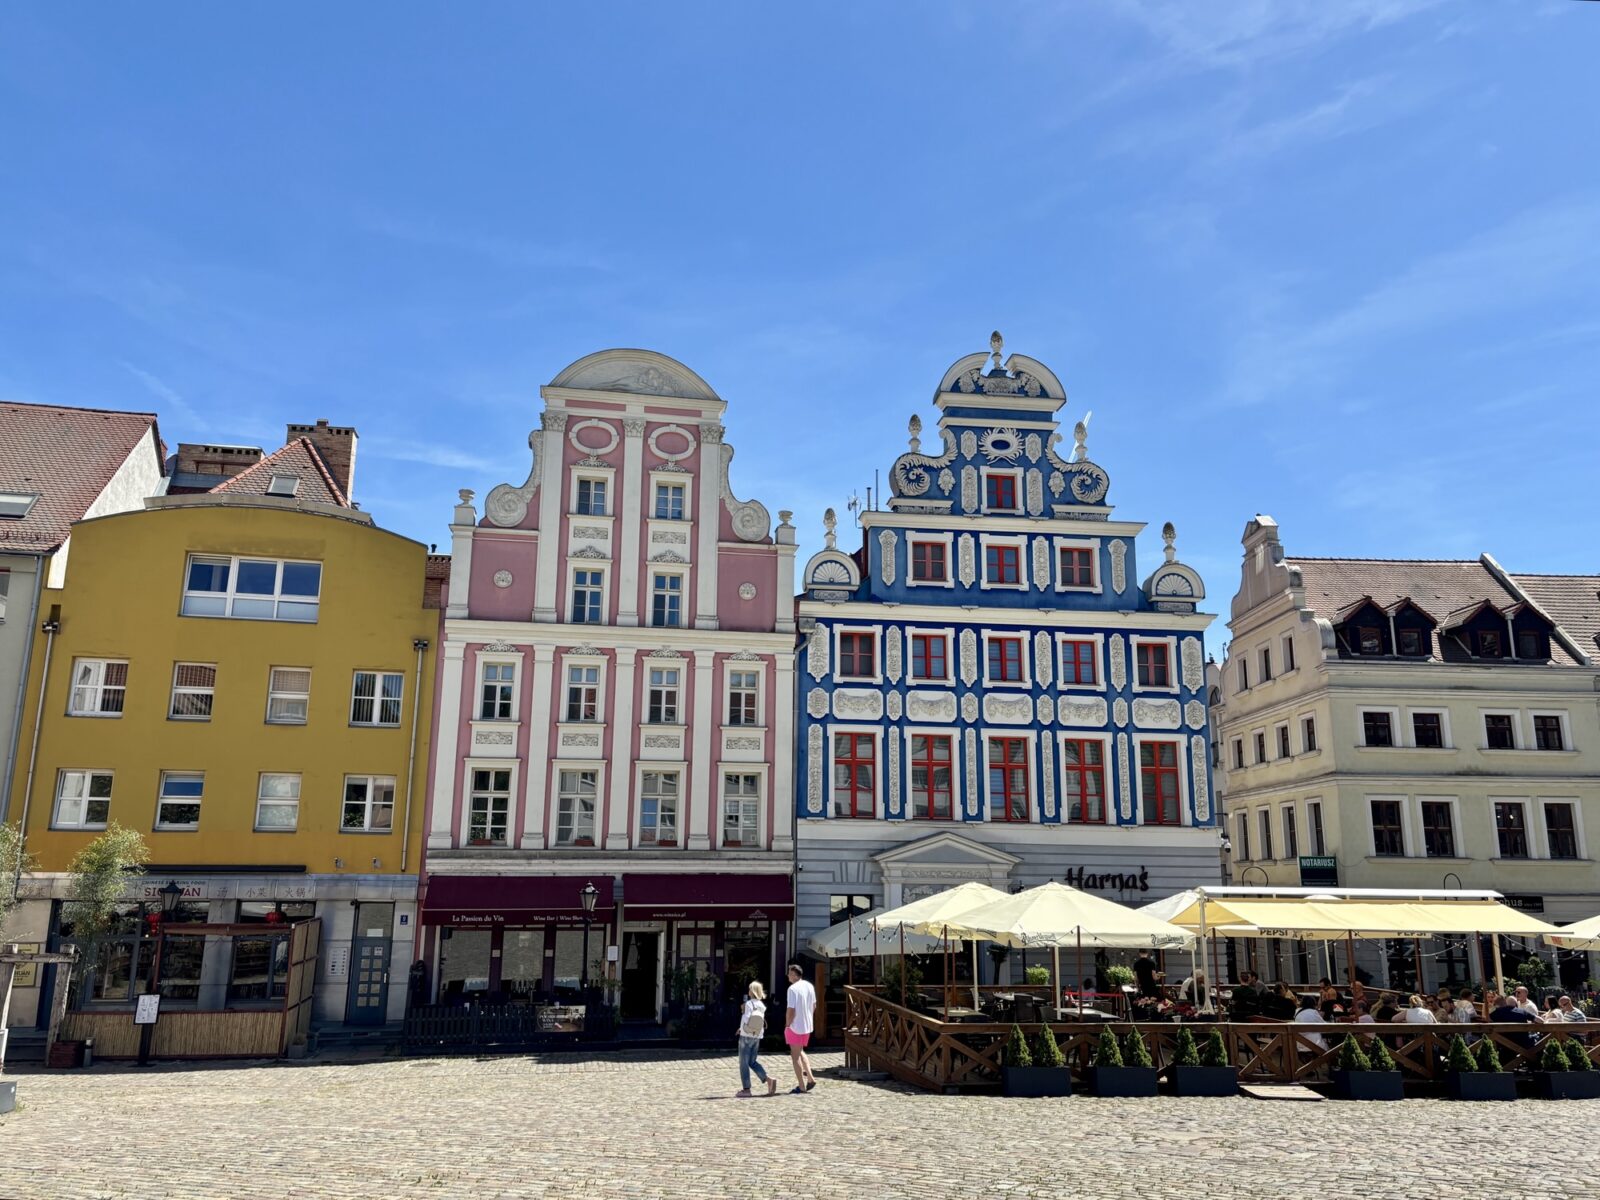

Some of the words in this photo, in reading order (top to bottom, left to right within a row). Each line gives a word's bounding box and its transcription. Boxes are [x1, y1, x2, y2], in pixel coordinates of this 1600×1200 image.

[1301, 858, 1335, 867] NOTARIUSZ
[452, 914, 460, 922] La
[461, 914, 483, 922] Passion
[484, 914, 492, 922] du
[493, 914, 505, 922] Vin
